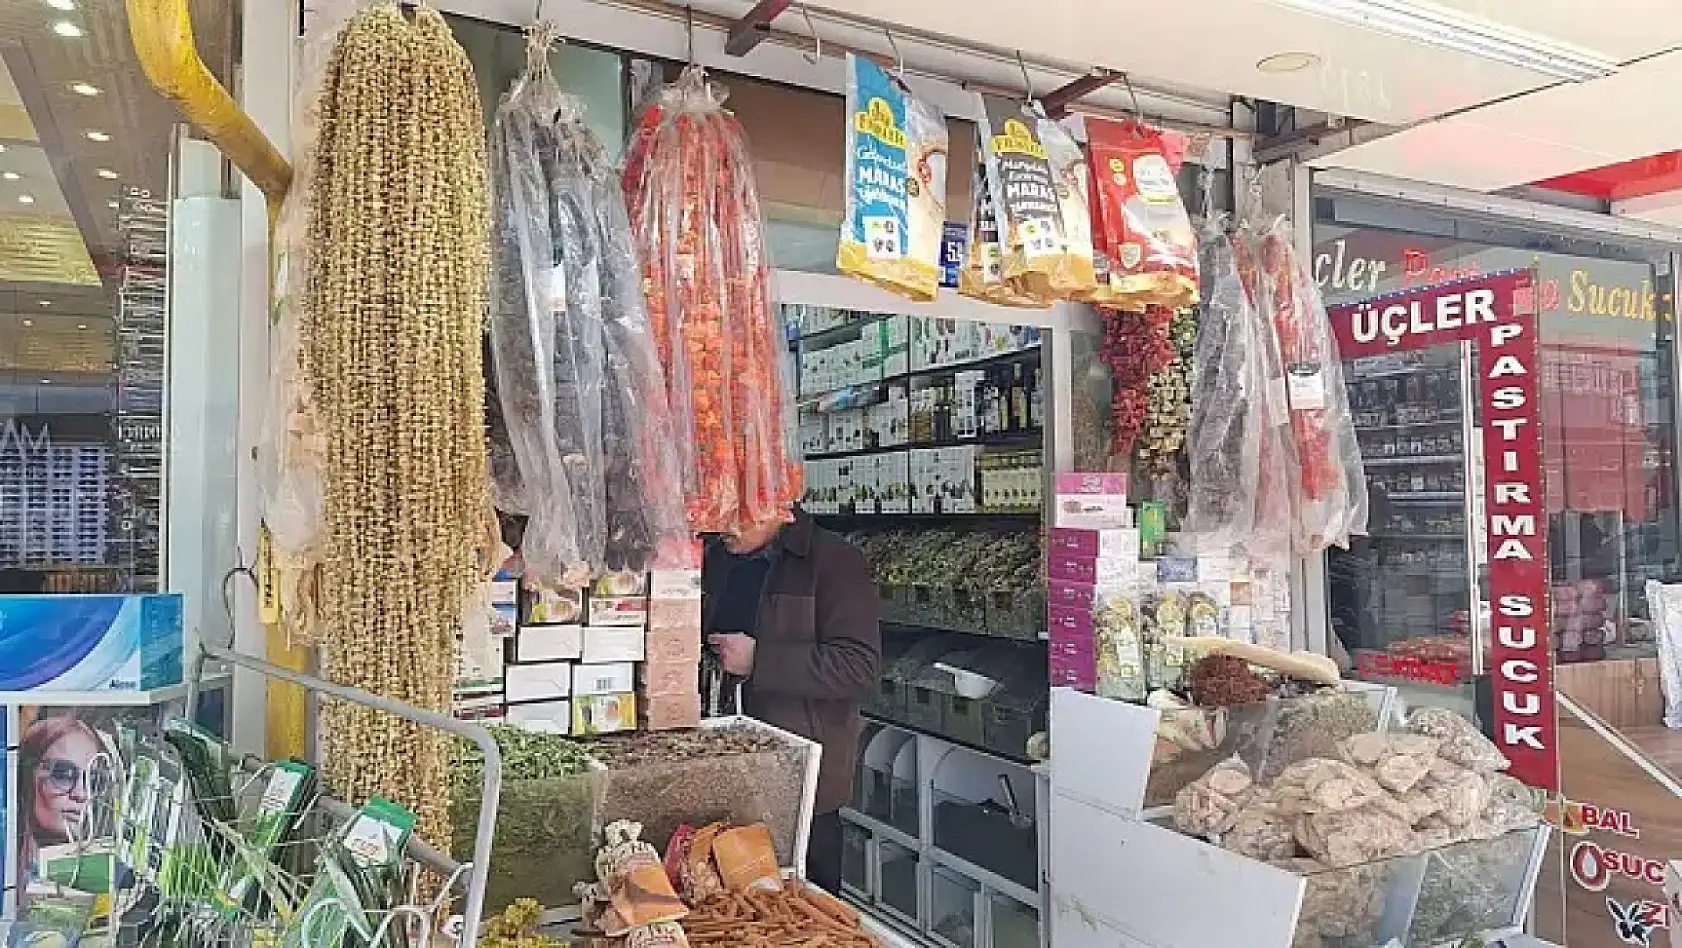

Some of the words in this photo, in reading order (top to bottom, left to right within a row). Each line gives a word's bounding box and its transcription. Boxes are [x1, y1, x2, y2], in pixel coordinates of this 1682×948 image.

[1351, 289, 1498, 345] ÜÇLER
[1487, 323, 1537, 560] PASTIRMA
[1497, 593, 1546, 751] SUCUK
[1580, 803, 1640, 838] BAL
